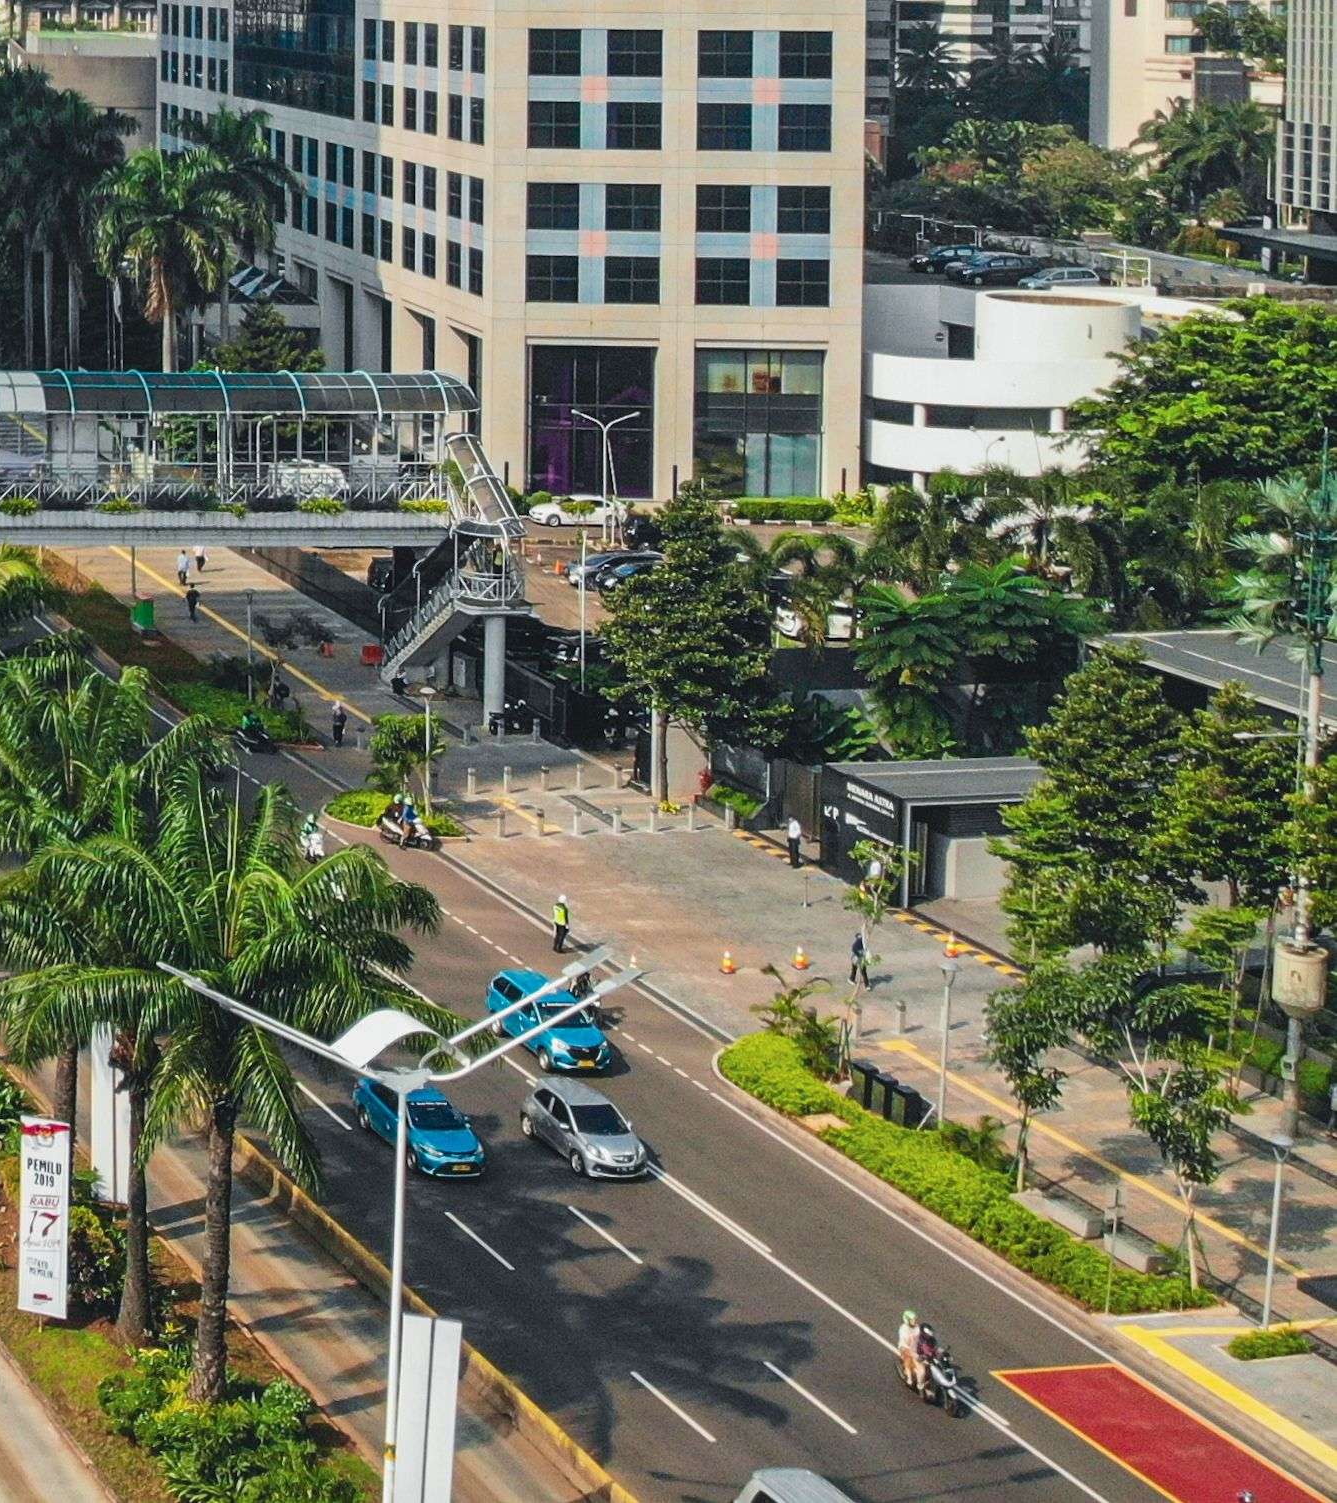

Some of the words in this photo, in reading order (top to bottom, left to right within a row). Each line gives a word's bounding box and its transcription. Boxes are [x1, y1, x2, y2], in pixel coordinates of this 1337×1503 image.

[874, 793, 894, 812] ASTRA
[27, 1157, 62, 1176] PEMILU
[34, 1172, 55, 1188] 2019
[29, 1196, 60, 1207] RABU
[29, 1209, 61, 1236] 17
